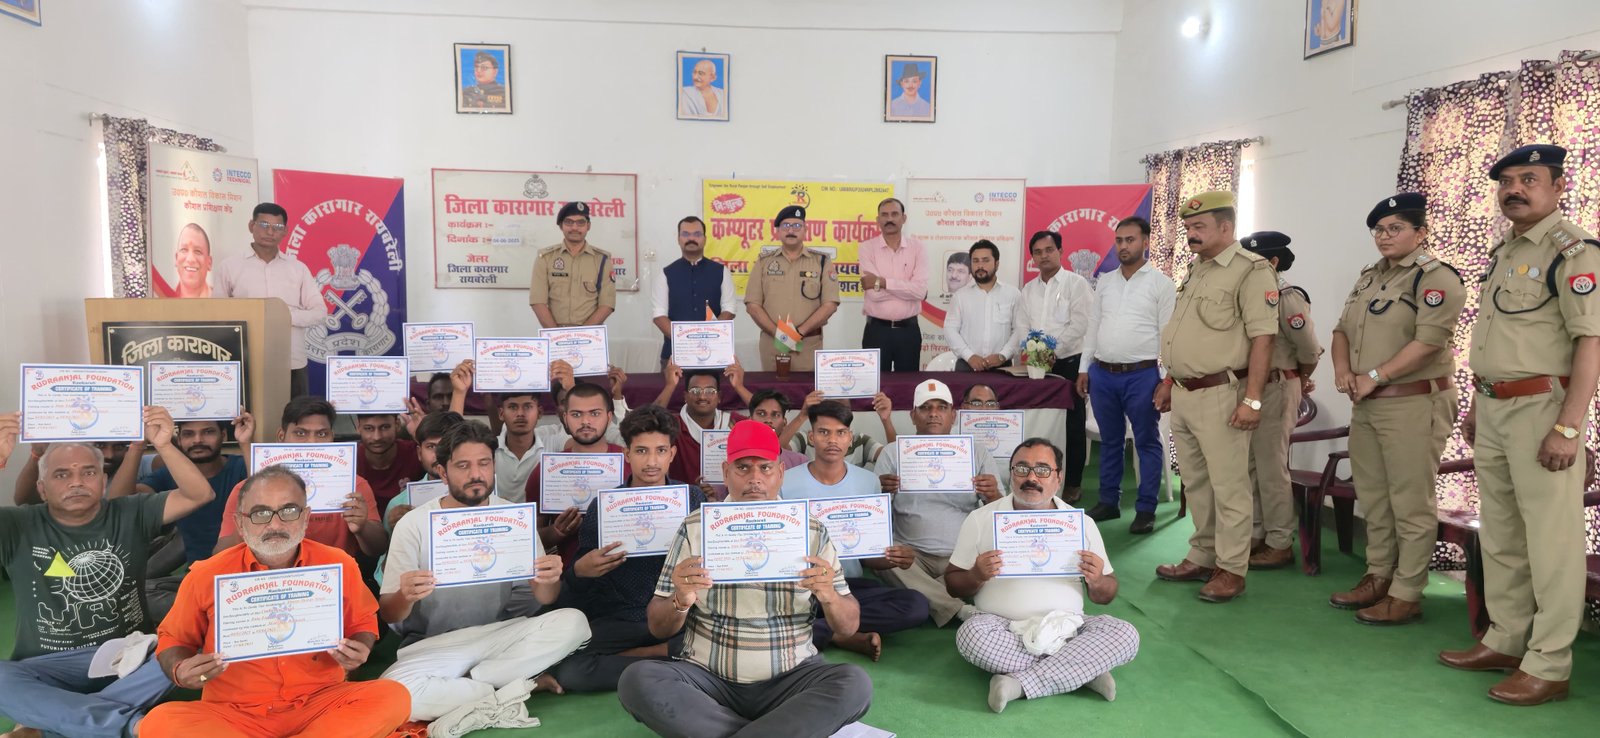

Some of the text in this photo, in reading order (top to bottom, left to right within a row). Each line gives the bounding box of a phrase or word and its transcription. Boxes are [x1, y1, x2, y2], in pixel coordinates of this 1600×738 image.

[226, 169, 252, 178] INTECCO
[444, 194, 489, 214] जिला
[494, 200, 554, 216] कारागार
[301, 199, 364, 225] कारागार
[365, 209, 402, 272] रायबरेली
[711, 218, 764, 248] कम्प्यूटर
[466, 254, 488, 263] जेलर
[448, 264, 471, 273] जिला
[460, 276, 496, 284] रायबरेली
[332, 336, 360, 348] प्रदेश
[122, 336, 232, 366] जिला कारागार
[31, 374, 134, 392] RUDRAANJAL FOUNDATION
[260, 452, 348, 467] RUDRAANJAL FOUNDATION
[606, 495, 681, 512] RUDRAANJAL FOUNDATION
[437, 515, 528, 536] RUDRAANJAL FOUNDATION
[710, 511, 800, 530] RUDRAANJAL FOUNDATION
[1000, 518, 1077, 533] RUDRAANJAL FOUNDATION
[226, 580, 333, 605] RUDRAANJAL FOUNDATION
